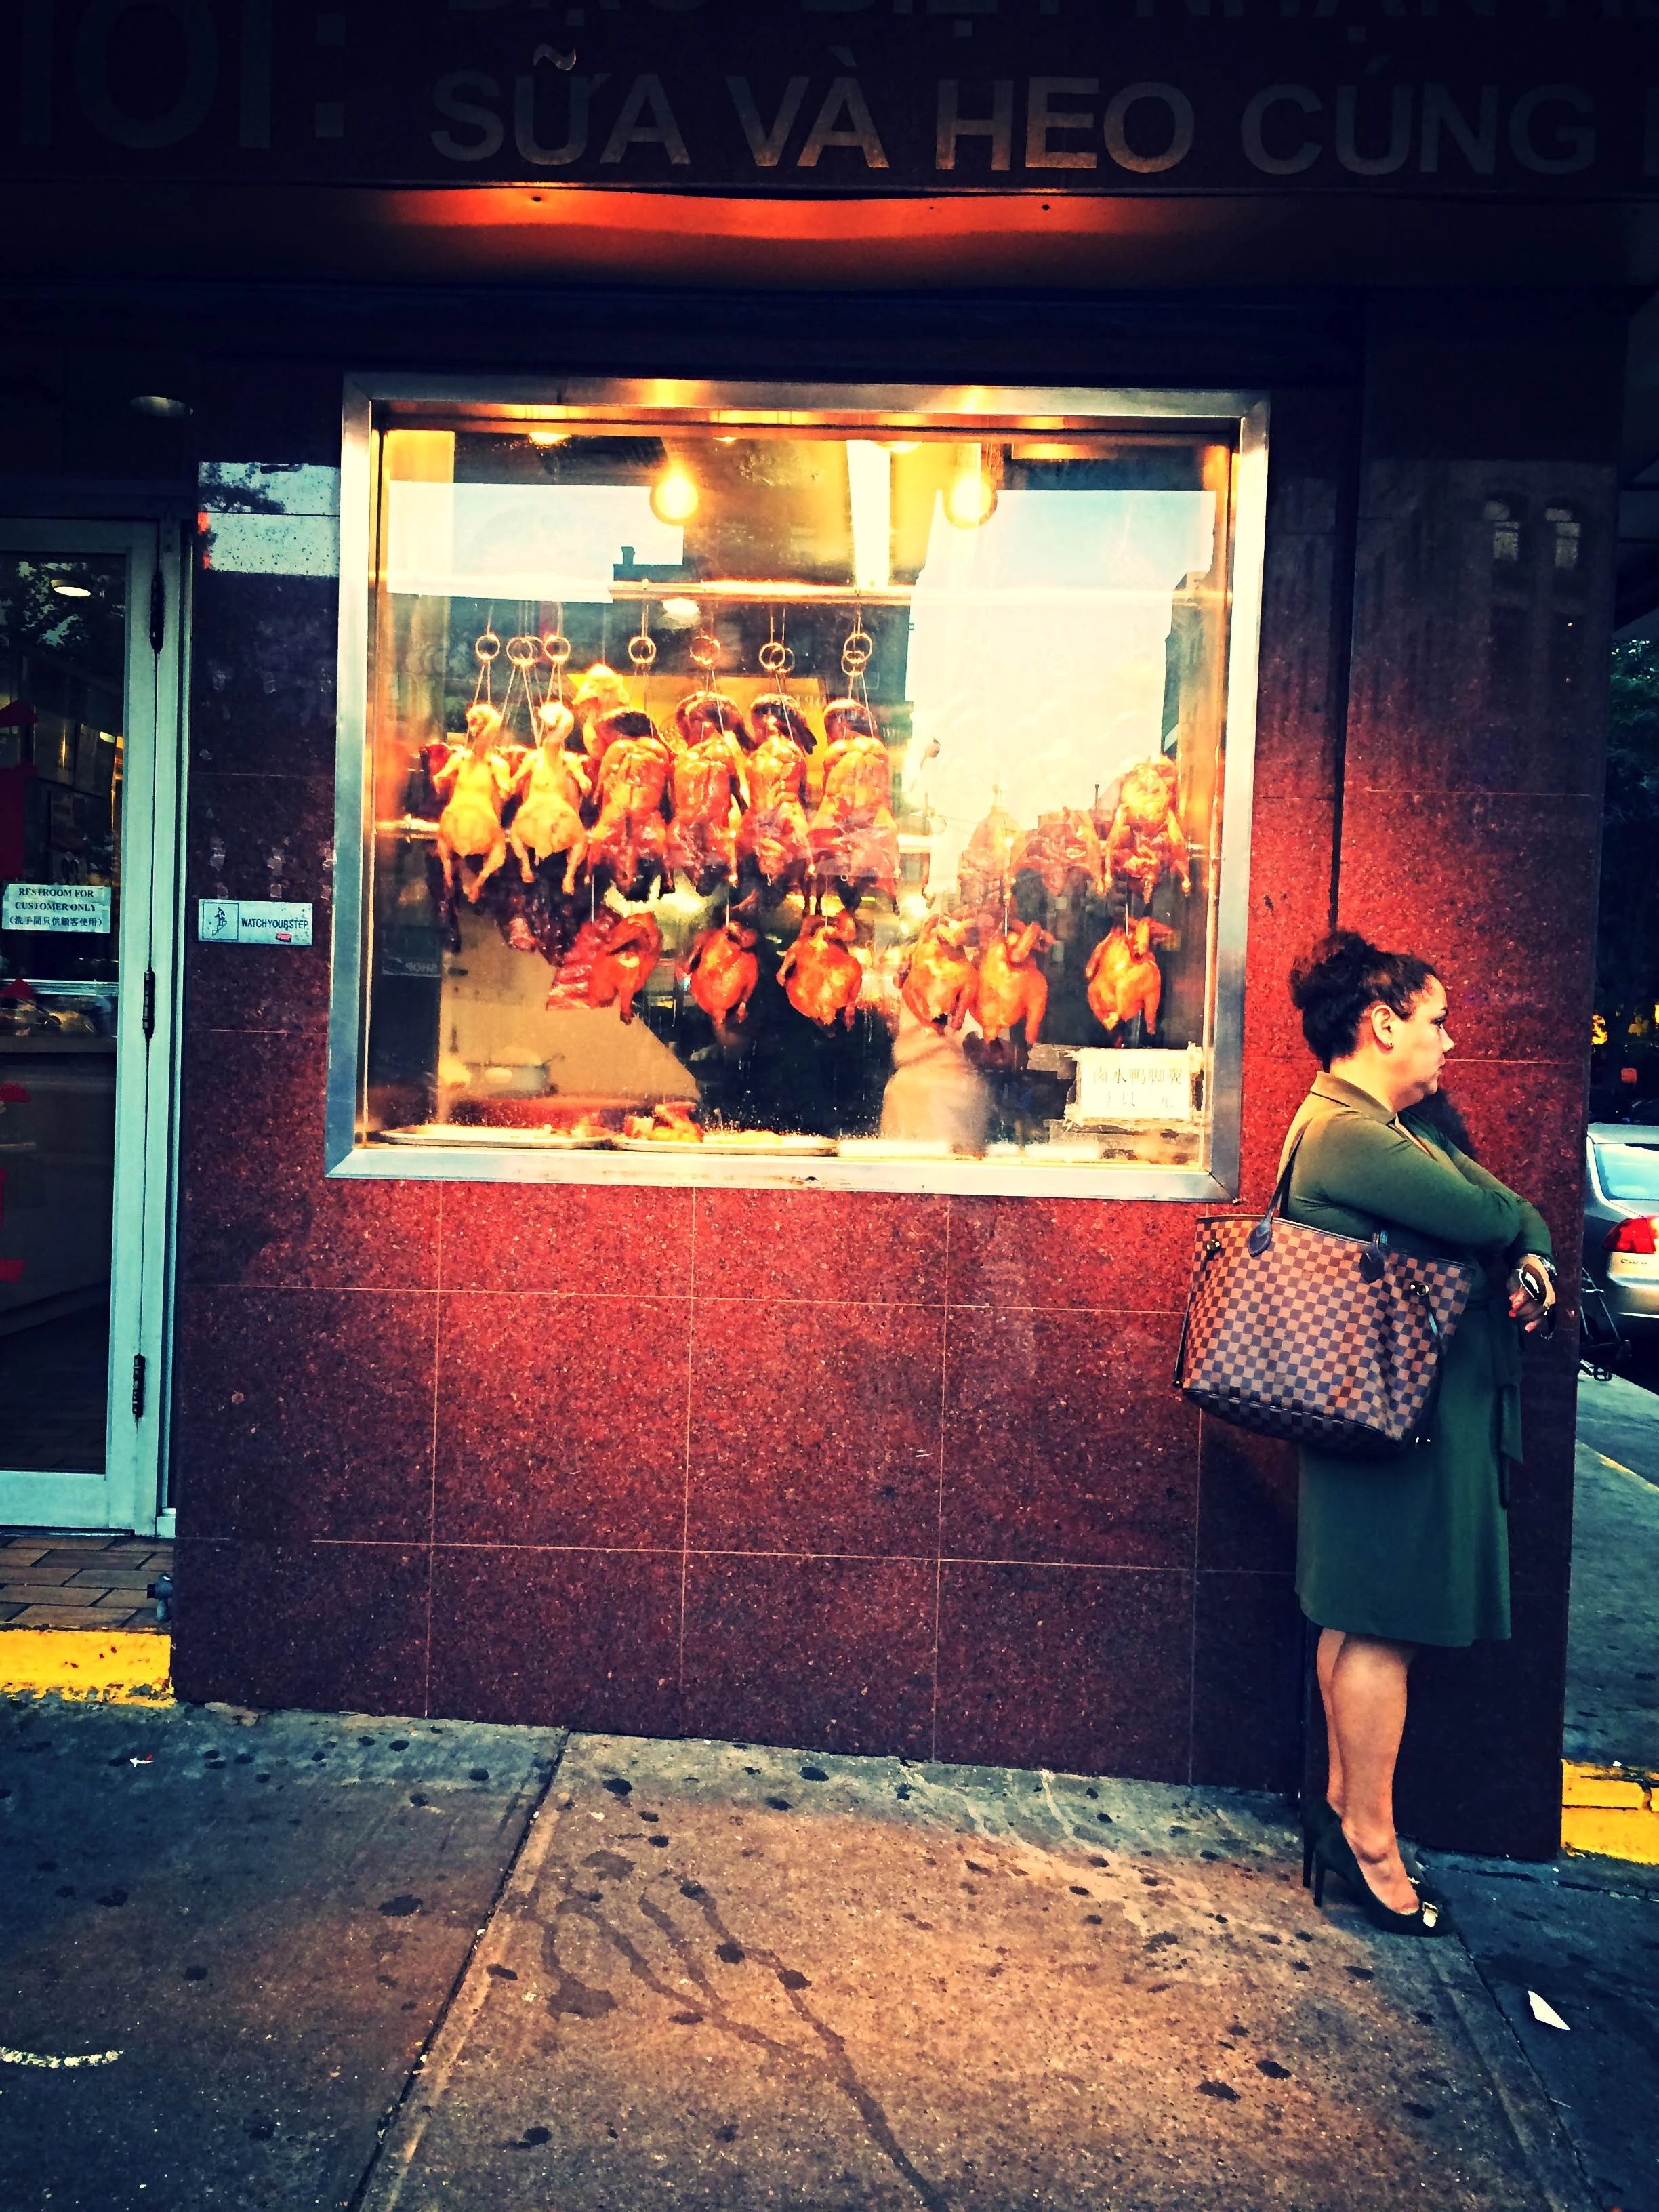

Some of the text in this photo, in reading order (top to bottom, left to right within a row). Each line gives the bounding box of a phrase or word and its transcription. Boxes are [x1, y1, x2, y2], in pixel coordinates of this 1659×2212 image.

[430, 43, 691, 166] SỮA
[724, 45, 890, 168] VÀ
[935, 76, 1195, 173] HEO
[19, 888, 94, 898] RESTROOM FOR
[15, 901, 96, 912] CUSTOMER ONLY
[241, 918, 308, 930] WATCH YOUR STEP
